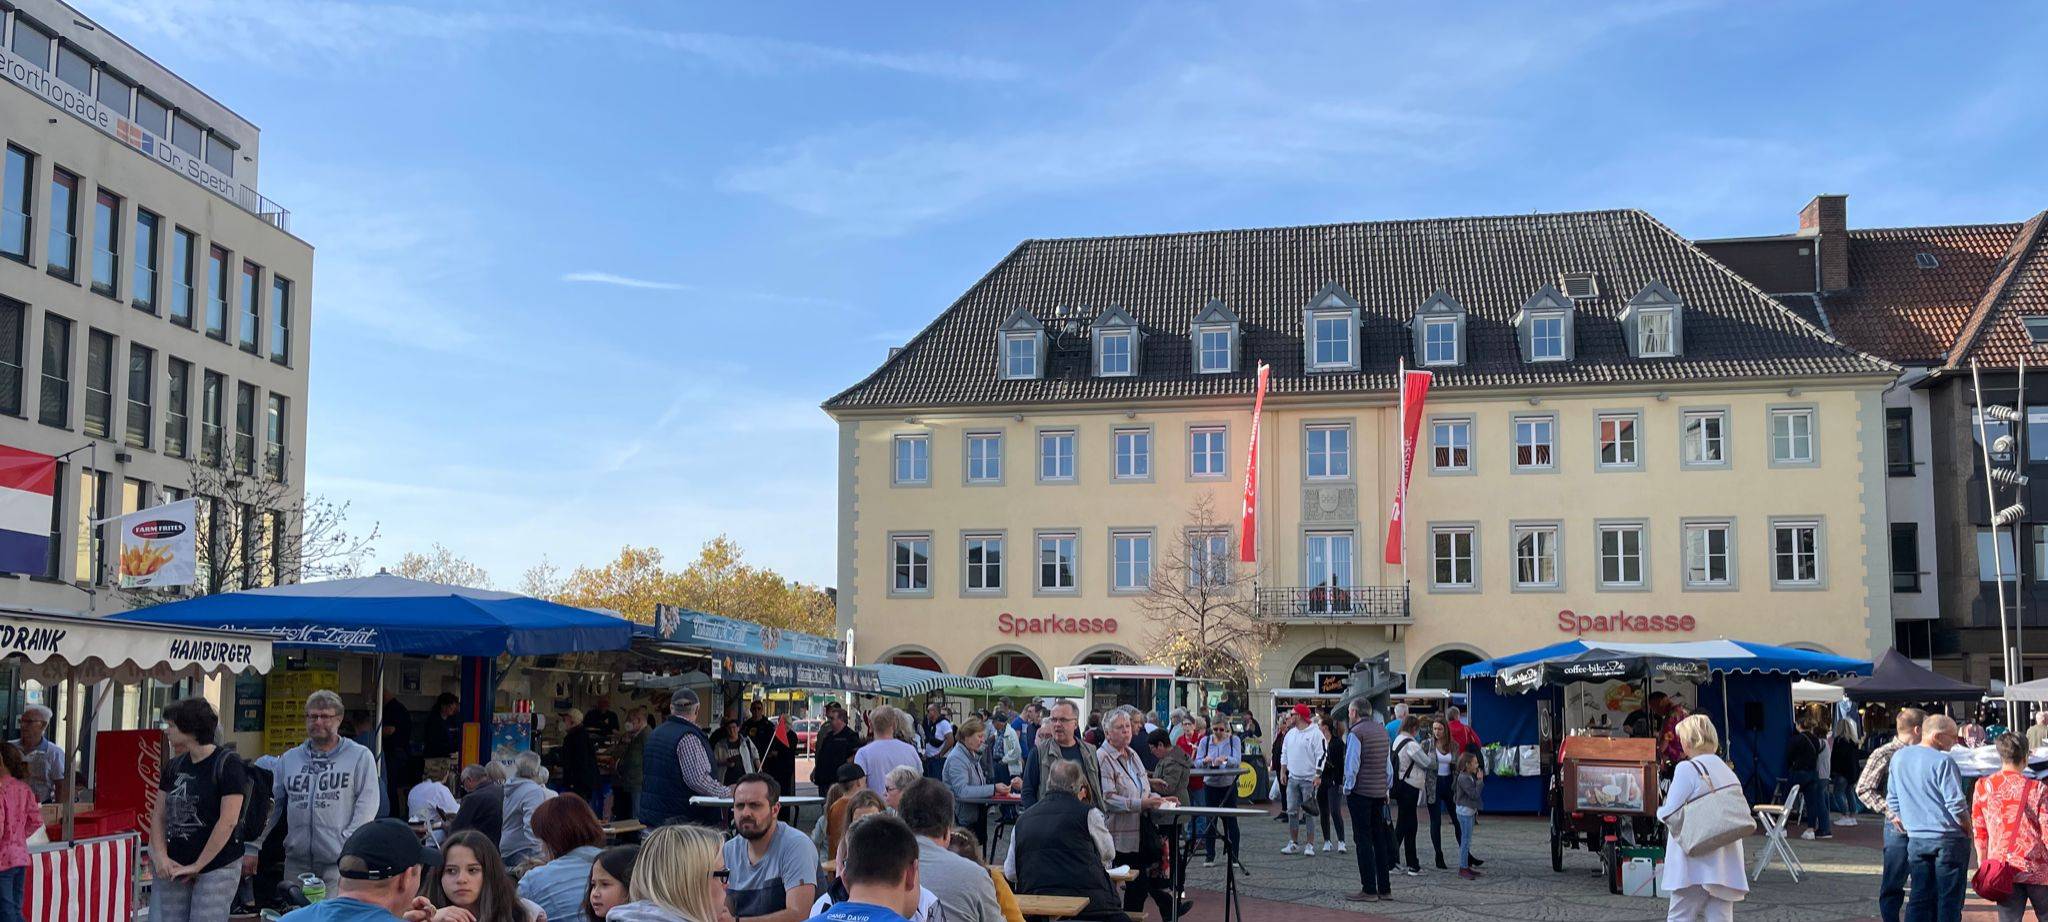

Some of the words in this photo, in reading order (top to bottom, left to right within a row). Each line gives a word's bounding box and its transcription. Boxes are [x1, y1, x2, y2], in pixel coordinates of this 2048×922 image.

[158, 142, 184, 171] Dr.
[187, 159, 235, 198] Speth
[135, 525, 158, 533] FARM
[158, 524, 183, 532] FRITES
[998, 613, 1118, 637] Sparkasse
[1558, 609, 1696, 636] Sparkasse
[169, 639, 252, 663] HAMBURGER
[287, 771, 351, 793] LEAGUE
